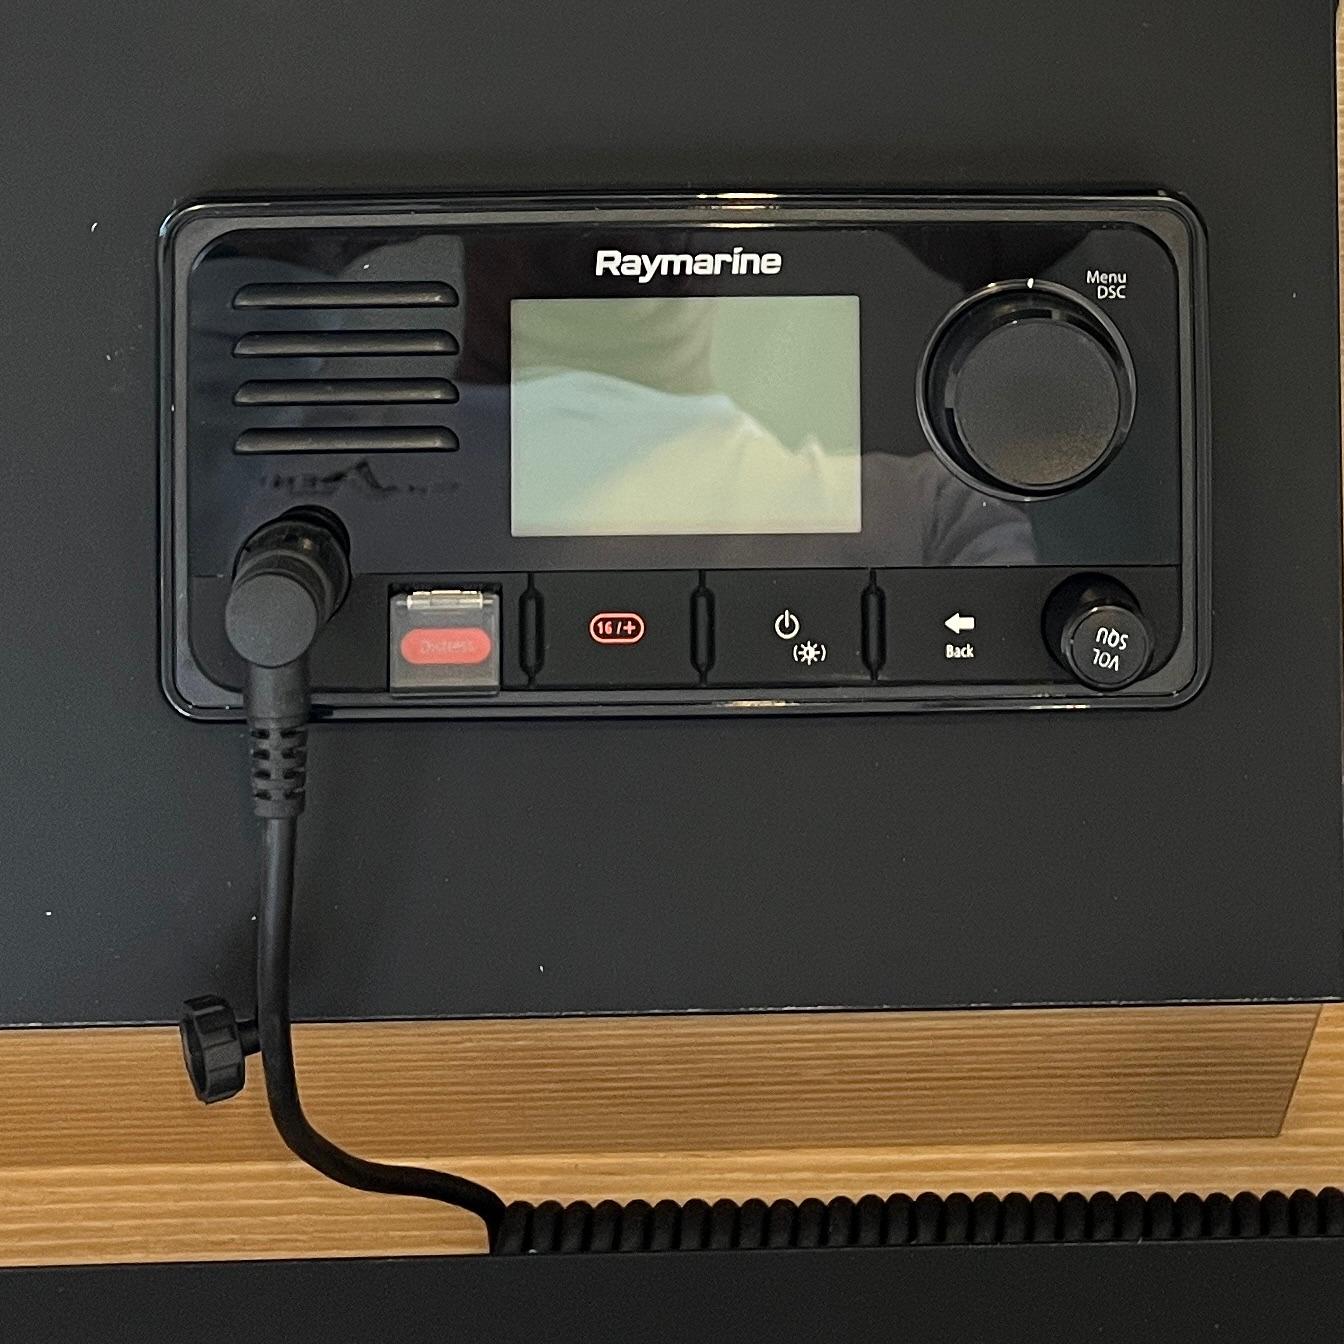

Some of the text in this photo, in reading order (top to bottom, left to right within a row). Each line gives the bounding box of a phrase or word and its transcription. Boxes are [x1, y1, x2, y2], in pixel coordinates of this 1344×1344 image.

[595, 246, 782, 284] Raymarine
[1086, 270, 1127, 284] Menu
[1097, 284, 1126, 299] DSC
[1095, 627, 1129, 651] SQU
[945, 643, 975, 659] Back
[1092, 647, 1119, 672] VOL
